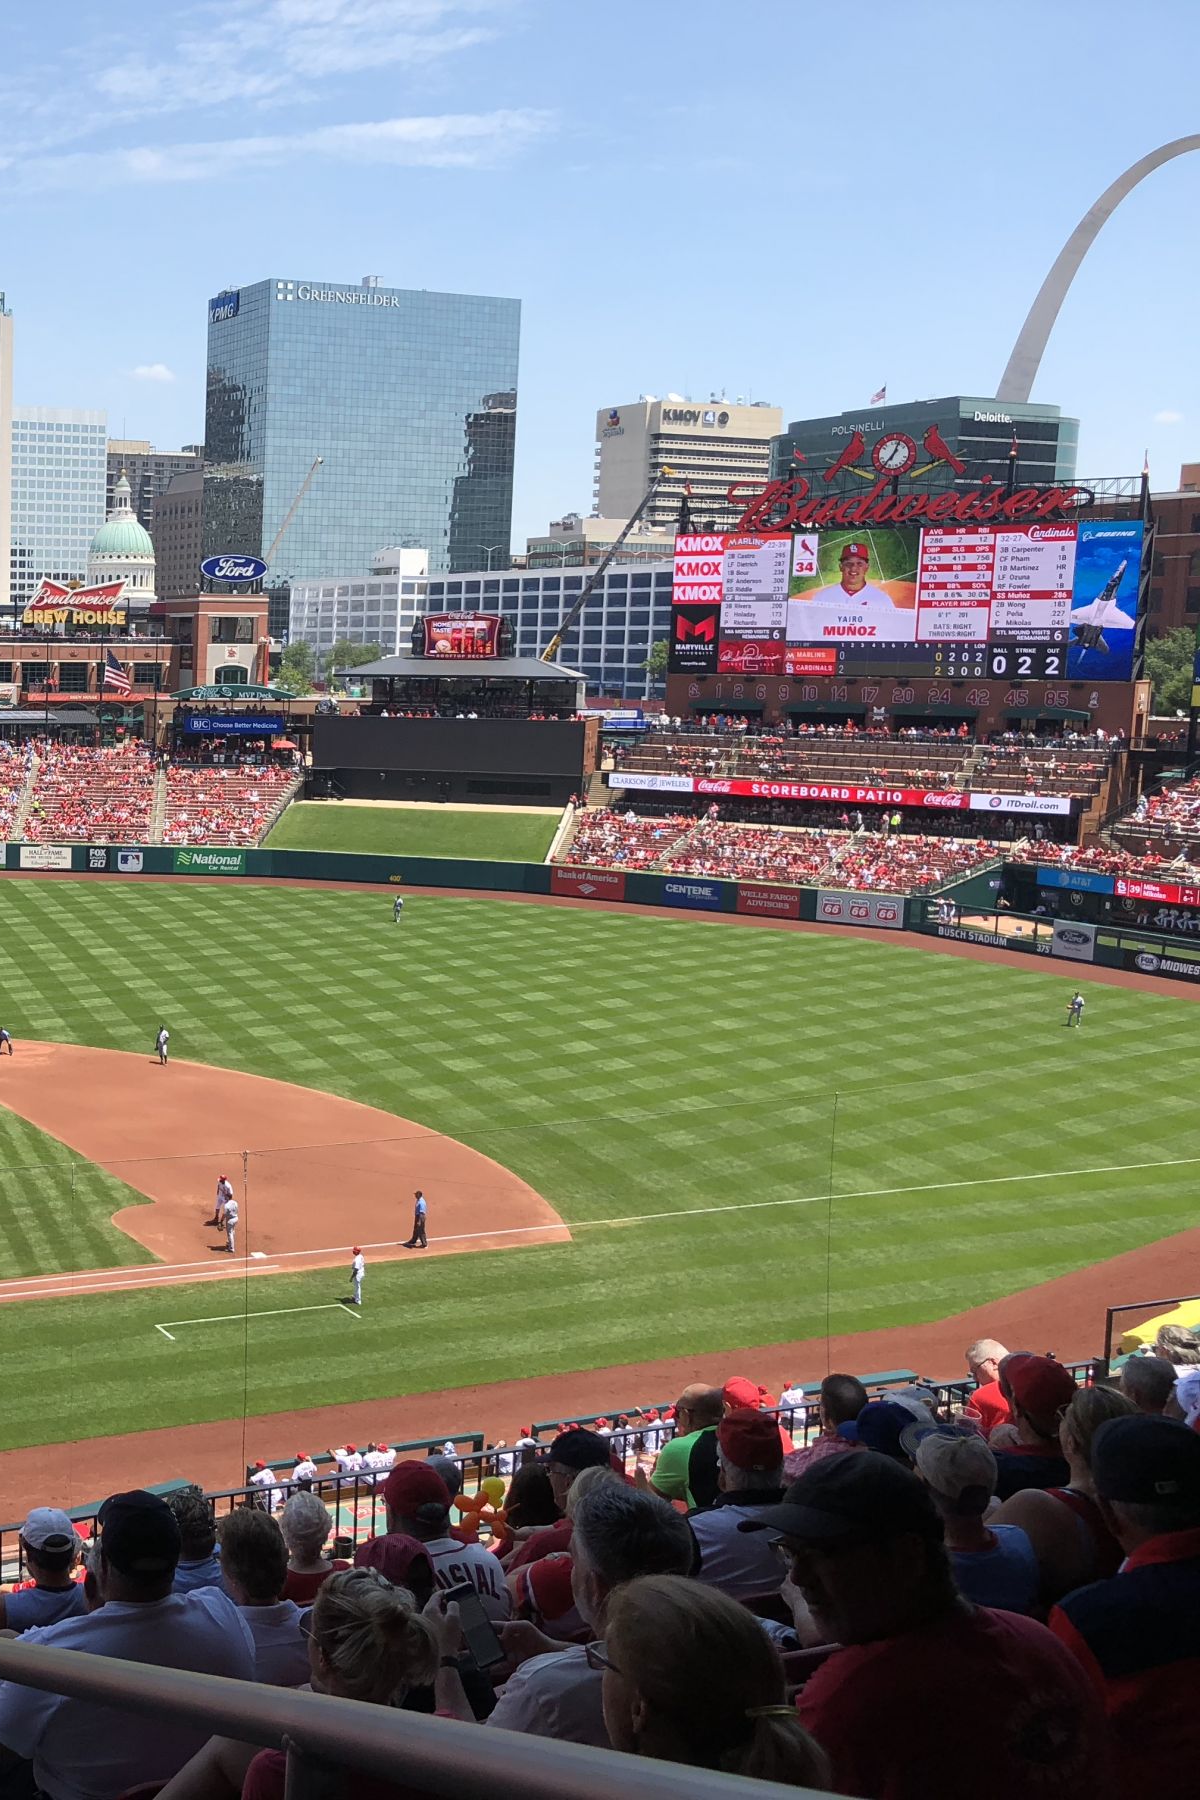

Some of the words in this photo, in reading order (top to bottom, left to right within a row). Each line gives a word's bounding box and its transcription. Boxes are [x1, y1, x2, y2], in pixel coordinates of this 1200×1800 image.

[298, 286, 400, 307] GREENSFELDER
[209, 302, 234, 321] KPMG
[662, 409, 701, 423] KMOV
[705, 411, 714, 421] 4
[974, 411, 1012, 424] Deloitte.
[831, 421, 884, 435] POLSINELLI
[728, 474, 1078, 532] Budweiser
[1028, 525, 1075, 540] Cardinals
[676, 536, 724, 552] KMOX
[728, 538, 765, 547] MARLINS
[215, 557, 255, 578] Ford
[675, 561, 722, 576] KMOX
[795, 562, 814, 572] 34
[30, 588, 127, 606] Budweiser
[673, 585, 720, 600] KMOX
[23, 610, 68, 624] BREW
[73, 611, 126, 625] HOUSE
[823, 623, 876, 636] MUÑOZ
[839, 651, 845, 659] 0
[935, 652, 942, 661] 0
[948, 652, 955, 661] 2
[961, 652, 969, 661] 0
[975, 652, 983, 661] 2
[796, 664, 833, 672] CARDINALS
[838, 665, 844, 674] 2
[934, 667, 941, 676] 2
[947, 666, 955, 676] 3
[960, 667, 968, 676] 0
[974, 667, 982, 676] 0
[992, 655, 1007, 674] 0
[1017, 656, 1031, 674] 2
[1045, 656, 1059, 674] 2
[801, 685, 818, 701] 10
[830, 685, 847, 702] 14
[861, 686, 879, 703] 17
[891, 687, 915, 704] 20
[928, 687, 950, 704] 24
[966, 688, 990, 706] 42
[1003, 689, 1029, 707] 45
[1044, 690, 1069, 707] 85
[193, 720, 208, 728] BJC
[613, 776, 646, 787] CLARKSON
[659, 779, 690, 789] JEWELERS
[698, 779, 732, 793] Coca-Cola
[752, 783, 850, 800] SCOREBOARD
[857, 789, 902, 802] PATIO
[923, 793, 962, 807] Coca-Cola
[1006, 800, 1059, 811] ITDroll.com
[89, 848, 106, 856] FOX
[89, 860, 105, 868] GO
[191, 853, 242, 865] National
[558, 870, 577, 880] Bank
[577, 871, 586, 880] of
[586, 872, 618, 884] America
[1071, 876, 1091, 887] AT&T
[665, 883, 712, 896] CENTENE
[1129, 885, 1140, 894] 39
[1143, 883, 1160, 892] Miles
[740, 890, 767, 899] WELLS
[769, 892, 797, 902] FARGO
[1142, 890, 1166, 899] Mikolas
[1183, 895, 1194, 903] 6-1
[746, 899, 790, 909] ADVISORS
[824, 904, 839, 914] 66
[851, 906, 866, 916] 66
[878, 909, 894, 919] 66
[938, 926, 966, 940] BUSCH
[968, 931, 1007, 946] STADIUM
[1062, 931, 1084, 944] Ford
[1140, 955, 1155, 964] FOX
[1160, 959, 1200, 976] MIDWES
[432, 1562, 501, 1601] USIAL
